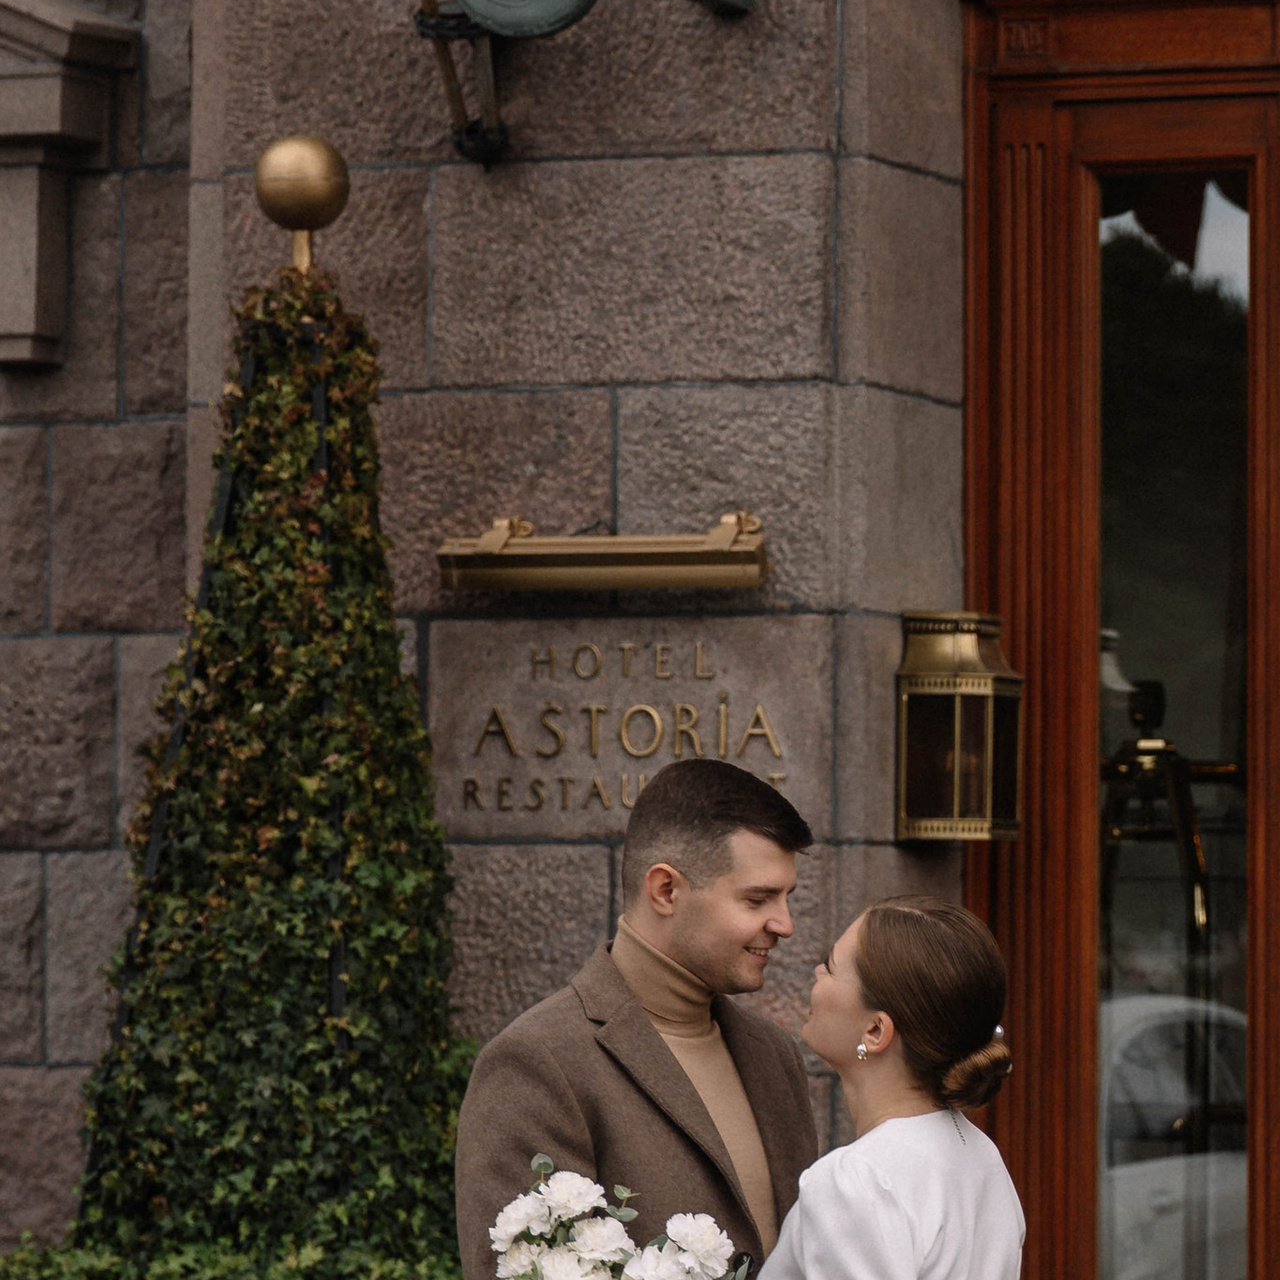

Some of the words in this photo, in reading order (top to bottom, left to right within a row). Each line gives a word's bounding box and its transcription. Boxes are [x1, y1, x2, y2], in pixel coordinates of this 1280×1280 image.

[531, 642, 716, 680] HOTEL
[473, 692, 783, 758] ASTORIA
[463, 773, 787, 811] RESTAUT
